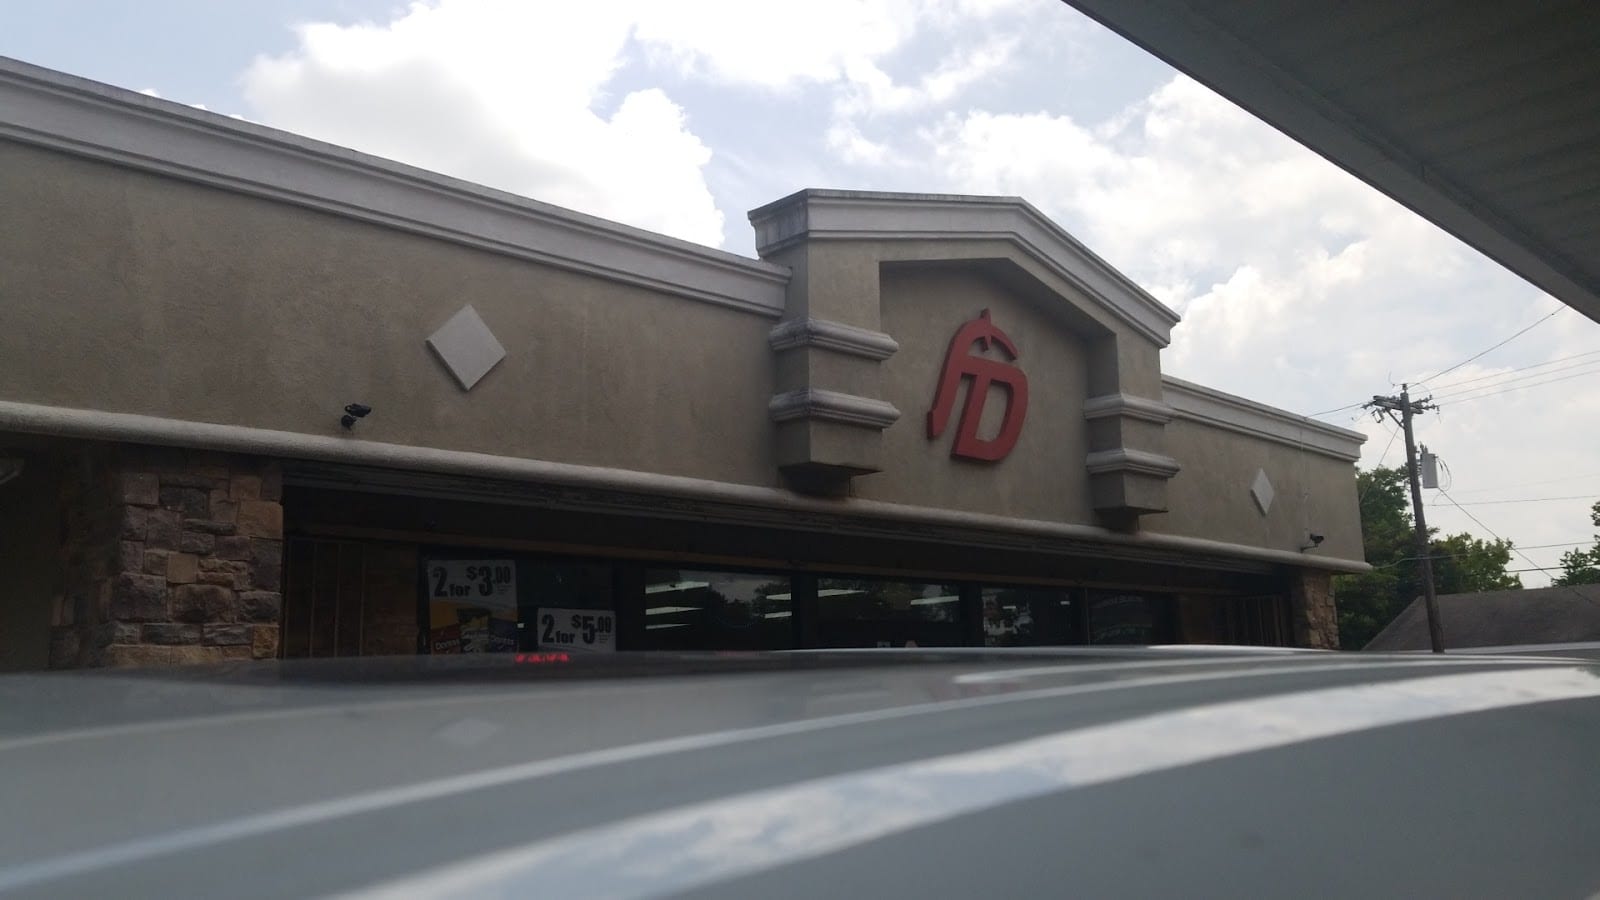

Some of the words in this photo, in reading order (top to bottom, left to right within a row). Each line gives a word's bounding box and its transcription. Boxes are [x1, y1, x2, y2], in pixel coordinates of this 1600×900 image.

[433, 566, 448, 597] 2
[449, 583, 471, 597] for
[466, 566, 511, 597] $3.00
[542, 614, 555, 643] 2
[556, 630, 575, 643] for
[571, 614, 612, 644] $5.00
